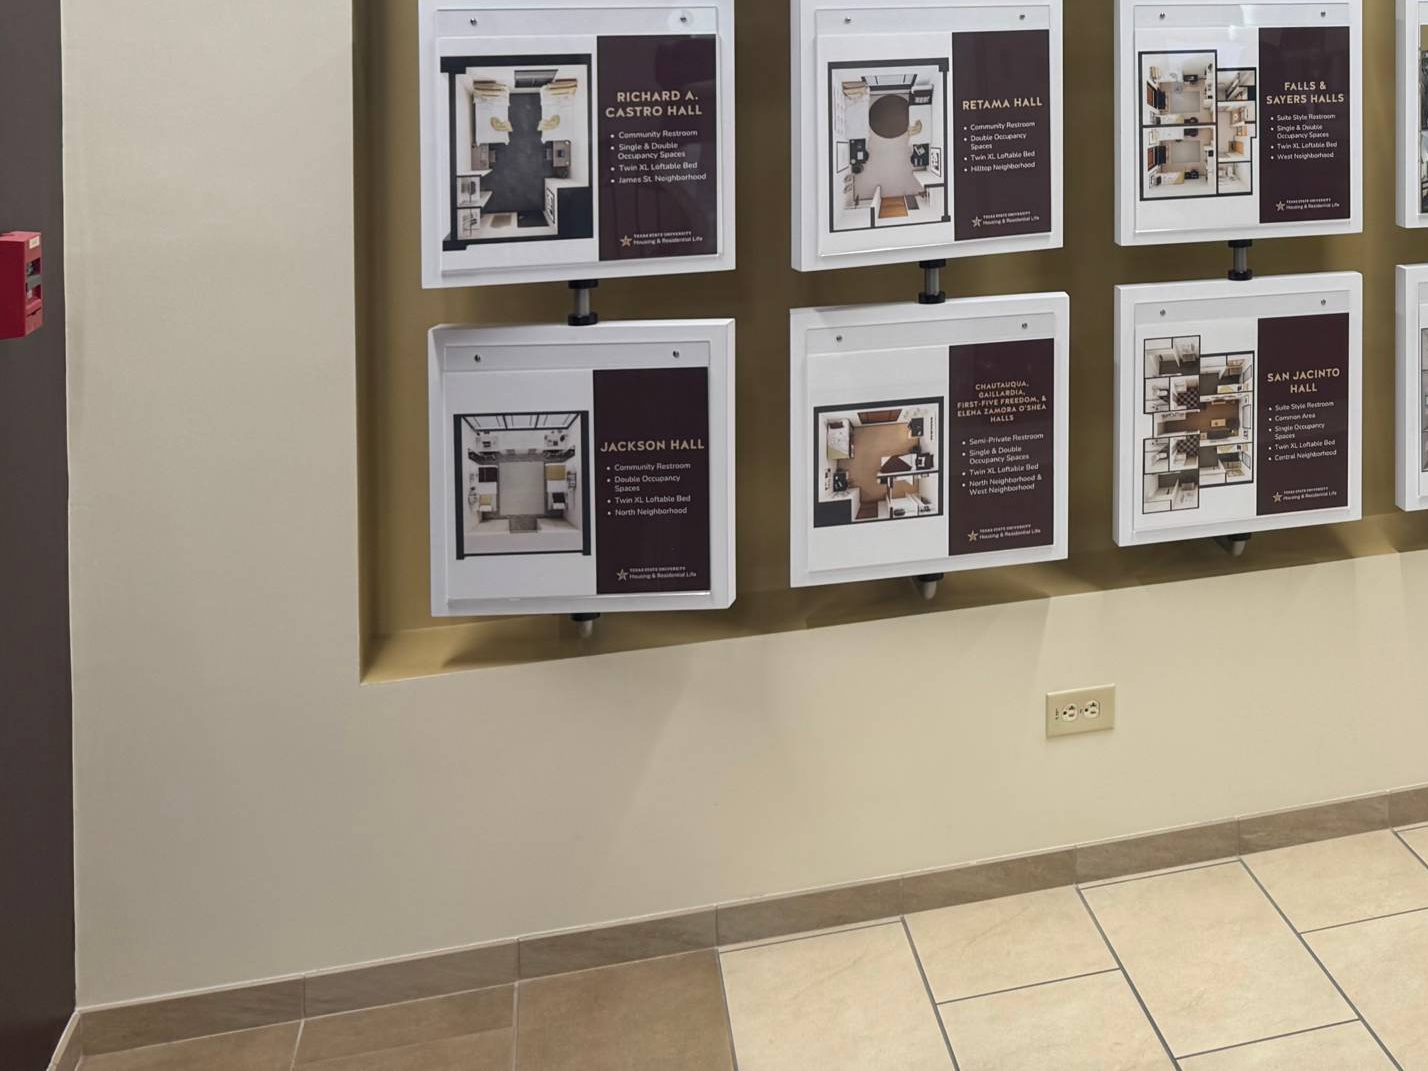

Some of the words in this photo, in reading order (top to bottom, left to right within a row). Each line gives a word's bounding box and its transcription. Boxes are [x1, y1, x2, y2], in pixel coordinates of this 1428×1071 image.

[1284, 81, 1316, 90] FALLS
[1320, 81, 1326, 89] &
[617, 91, 680, 102] RICHARD
[685, 91, 698, 100] A.
[1266, 95, 1307, 104] SAYERS
[1311, 94, 1344, 103] HALLS
[962, 99, 1009, 110] RETAMA
[1014, 97, 1042, 107] HALL
[605, 106, 662, 118] CASTRO
[667, 105, 702, 115] HALL
[619, 131, 661, 139] Community
[619, 143, 642, 151] Single
[618, 152, 658, 160] Occupancy
[660, 151, 685, 159] Spaces
[997, 152, 1021, 160] Loftable
[993, 163, 1035, 171] Neighborhood
[655, 174, 706, 183] Neighborhood
[1267, 372, 1290, 382] SAN
[1293, 368, 1340, 380] JACINTO
[1290, 383, 1317, 393] HALL
[957, 399, 998, 408] FIRST-FIVE
[957, 409, 981, 417] ELENA
[984, 407, 1016, 415] ZAMORA
[969, 437, 1011, 445] Semi-Private
[1013, 433, 1044, 441] Restroom
[601, 440, 665, 452] JACKSON
[671, 439, 704, 449] HALL
[969, 448, 990, 457] Single
[1275, 453, 1295, 461] Central
[1297, 450, 1336, 459] Neighborhood
[969, 456, 1005, 464] Occupancy
[1006, 454, 1029, 462] Spaces
[998, 465, 1024, 473] Loftable
[990, 475, 1035, 485] Neighborhood
[989, 484, 1035, 494] Neighborhood
[637, 507, 687, 515] Neighborhood
